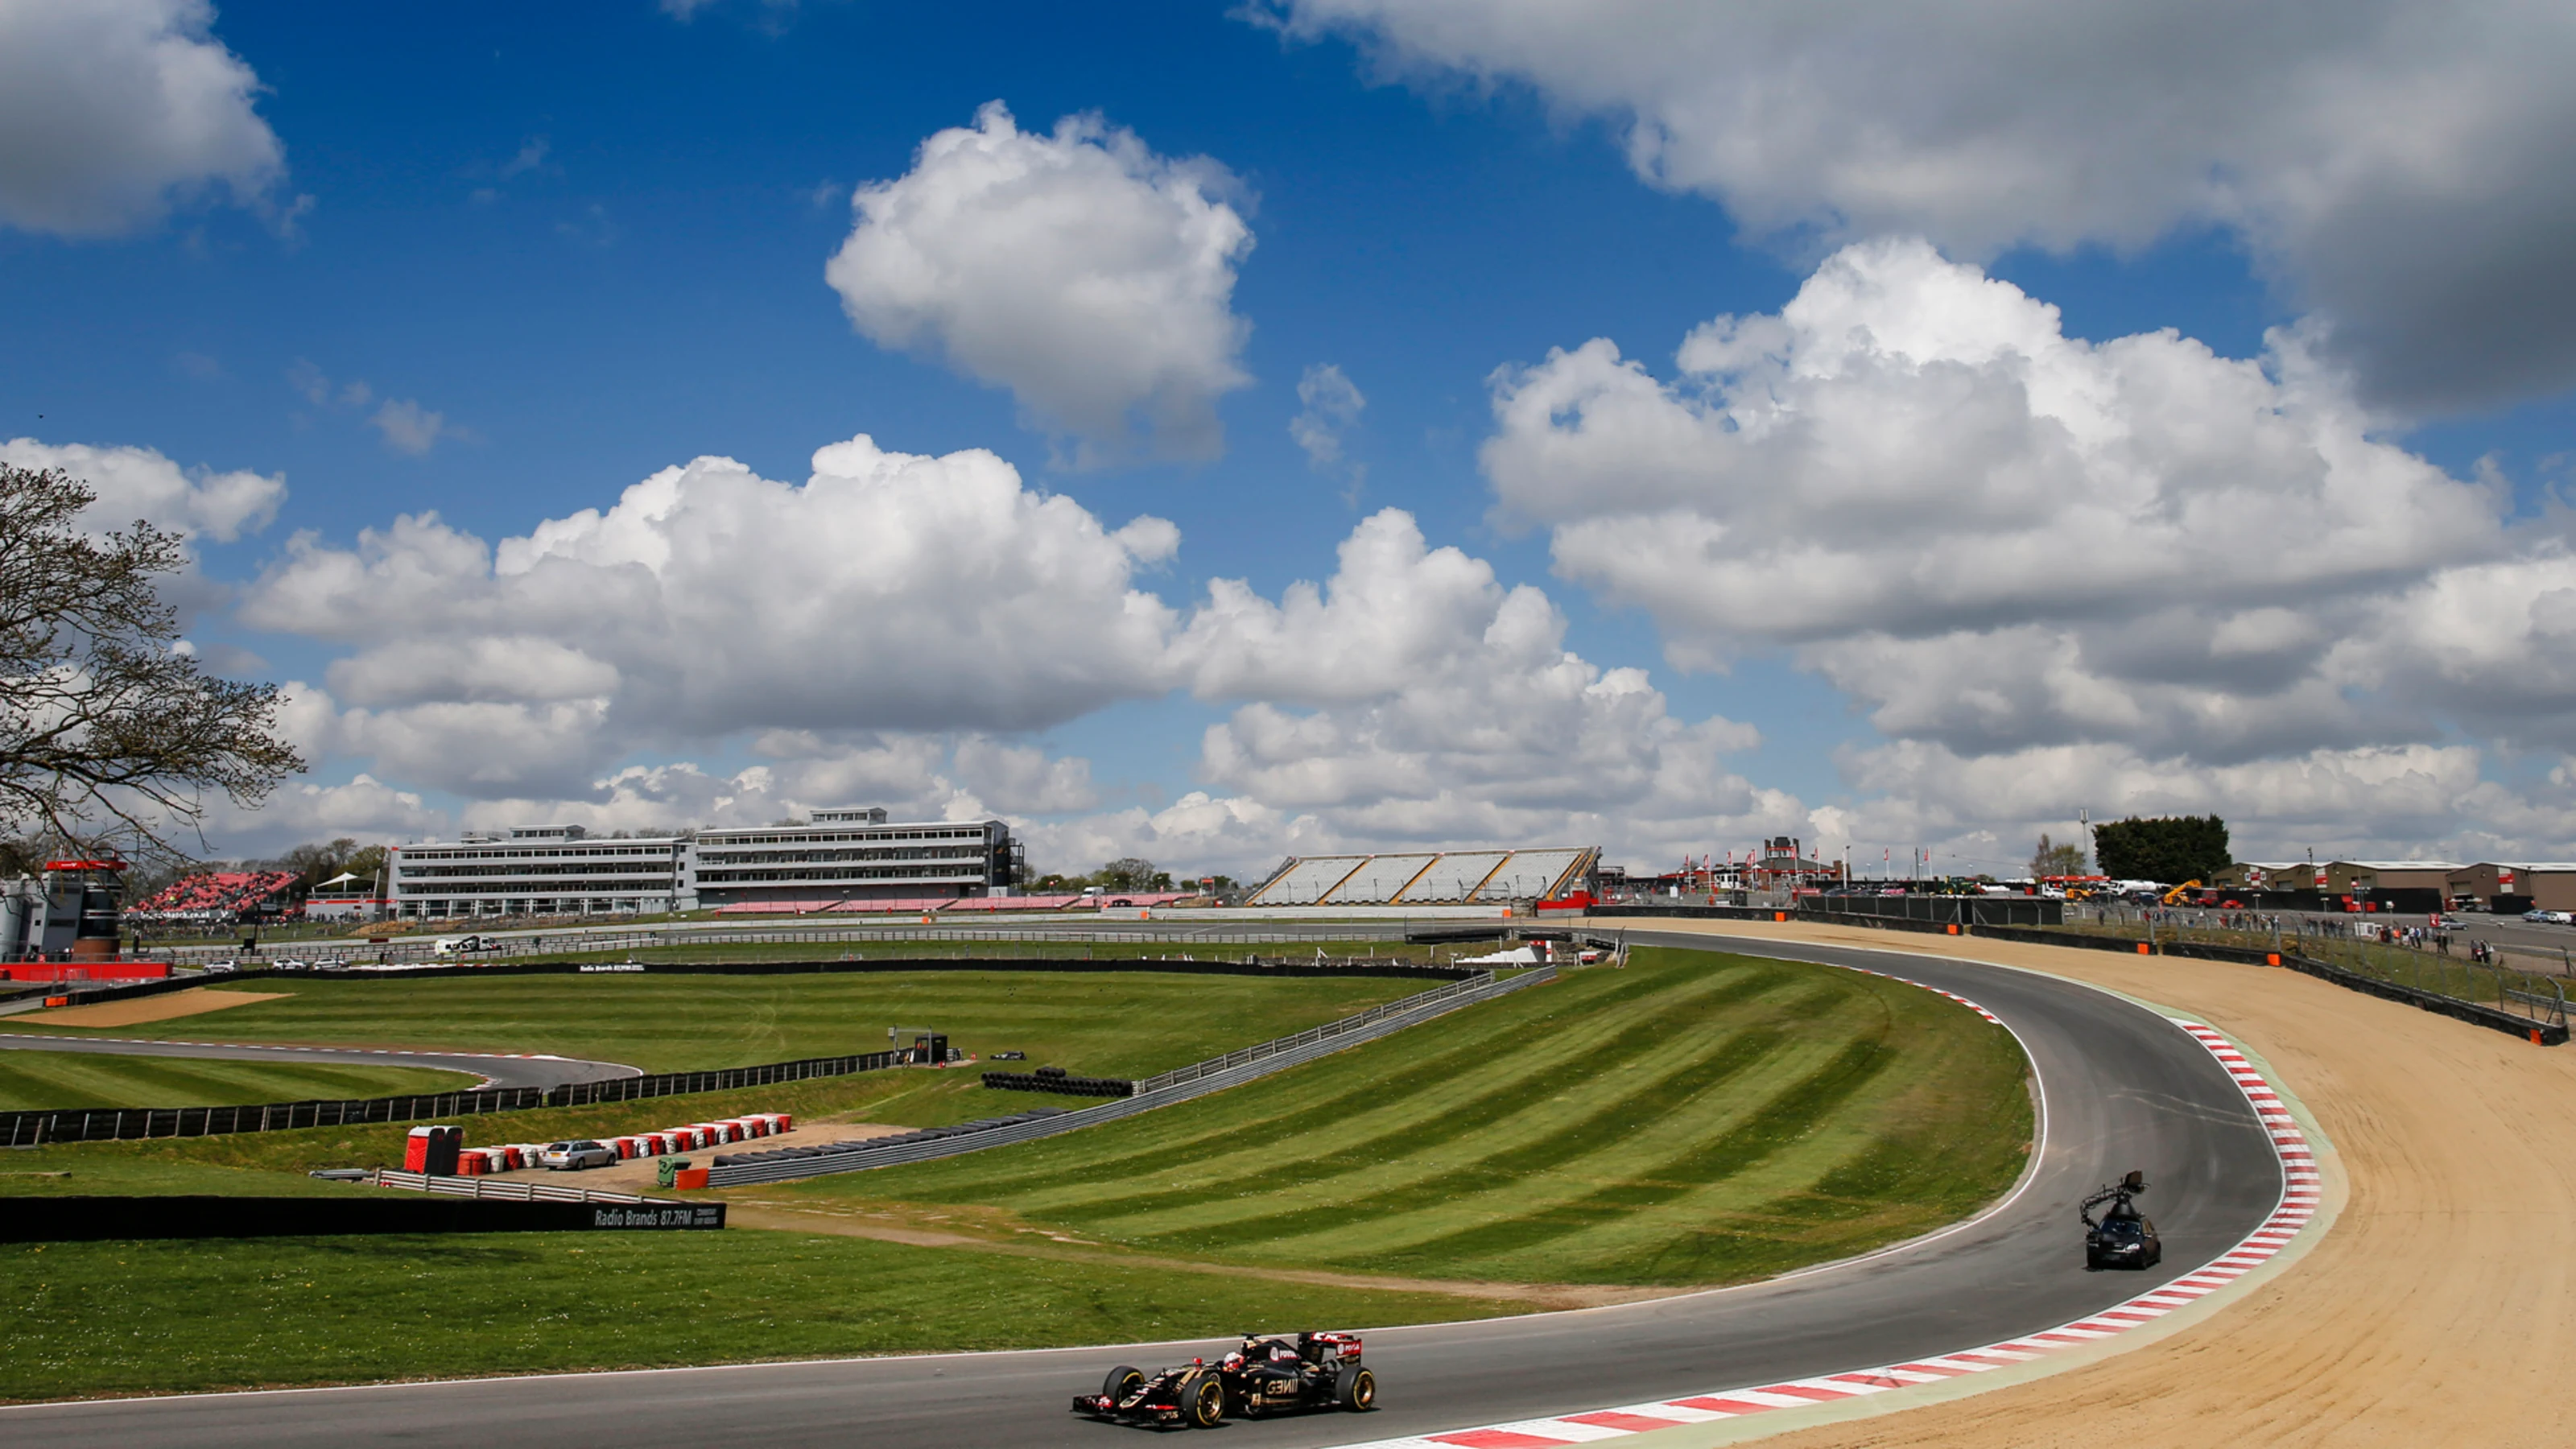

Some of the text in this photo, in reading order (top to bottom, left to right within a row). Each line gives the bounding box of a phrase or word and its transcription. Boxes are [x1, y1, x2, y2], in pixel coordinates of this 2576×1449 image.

[595, 1208, 623, 1226] Radio
[625, 1209, 658, 1226] Brands
[660, 1210, 692, 1226] 87.7FM
